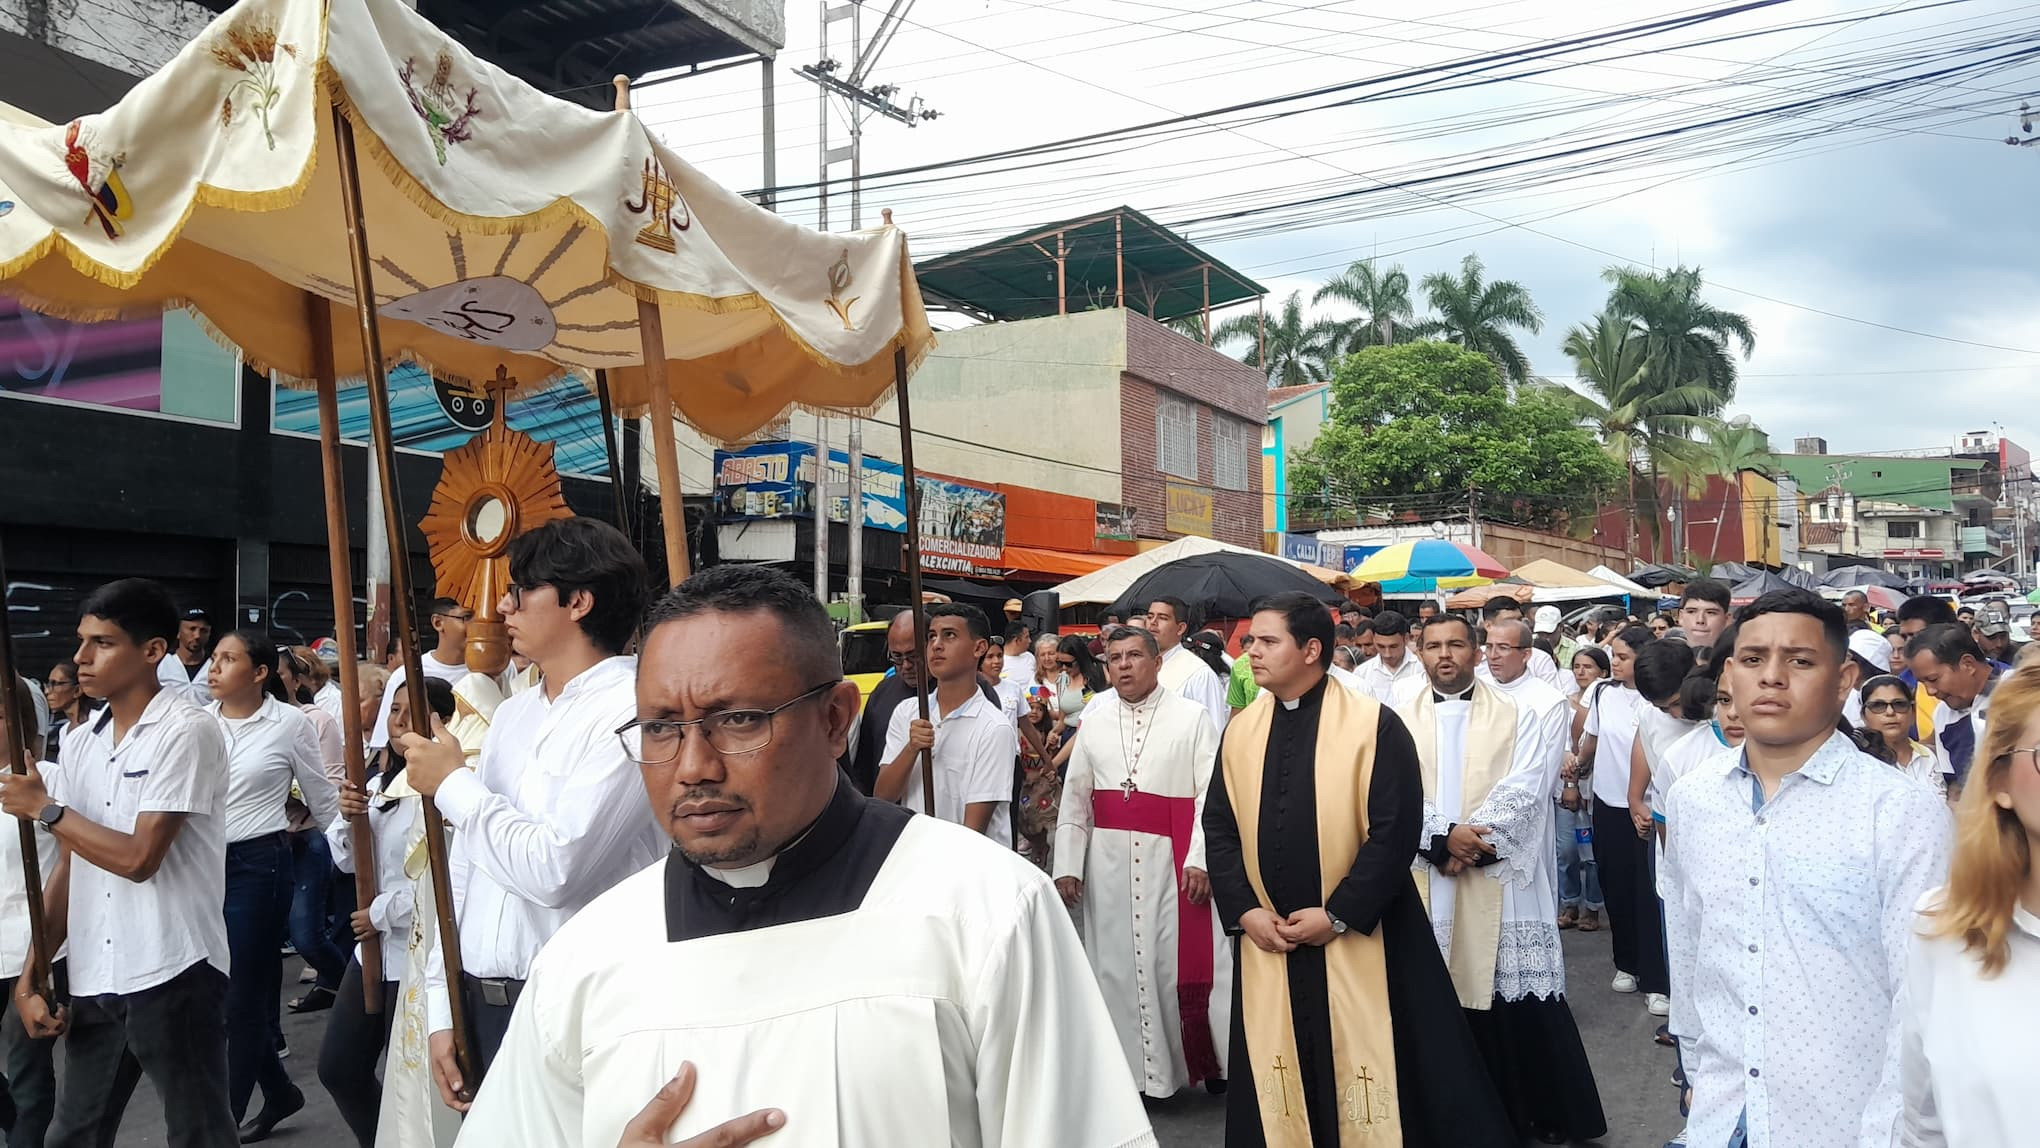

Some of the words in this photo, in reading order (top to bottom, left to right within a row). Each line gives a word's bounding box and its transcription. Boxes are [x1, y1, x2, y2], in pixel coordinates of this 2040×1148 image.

[720, 453, 789, 486] ABASTO
[919, 536, 1001, 561] COMERCIALIZADORA
[1296, 543, 1316, 561] CALZA
